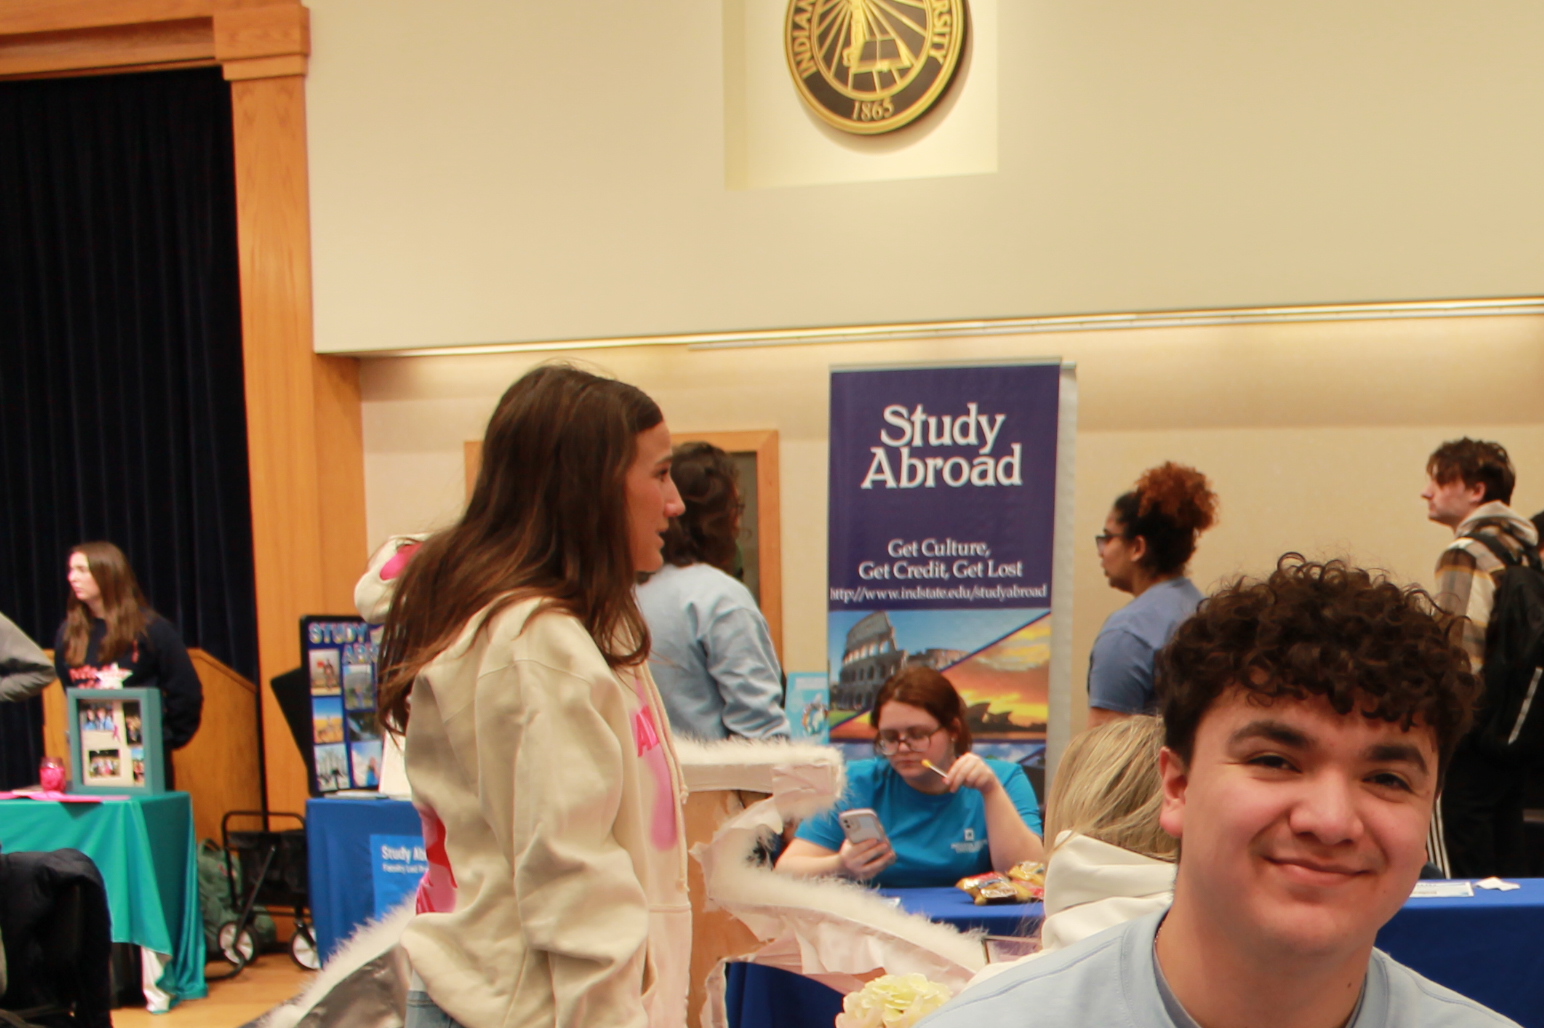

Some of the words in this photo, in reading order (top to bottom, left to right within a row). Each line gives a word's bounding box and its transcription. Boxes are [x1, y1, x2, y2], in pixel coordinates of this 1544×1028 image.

[853, 99, 894, 121] 1865
[880, 402, 1006, 455] Study
[860, 442, 1023, 489] Abroad
[887, 539, 918, 557] Get
[921, 537, 991, 558] Culture,
[858, 561, 890, 580] Get
[893, 560, 950, 580] Credit,
[953, 559, 983, 579] Get
[987, 559, 1023, 578] Lost
[308, 622, 368, 644] STUDY
[381, 844, 412, 864] Study
